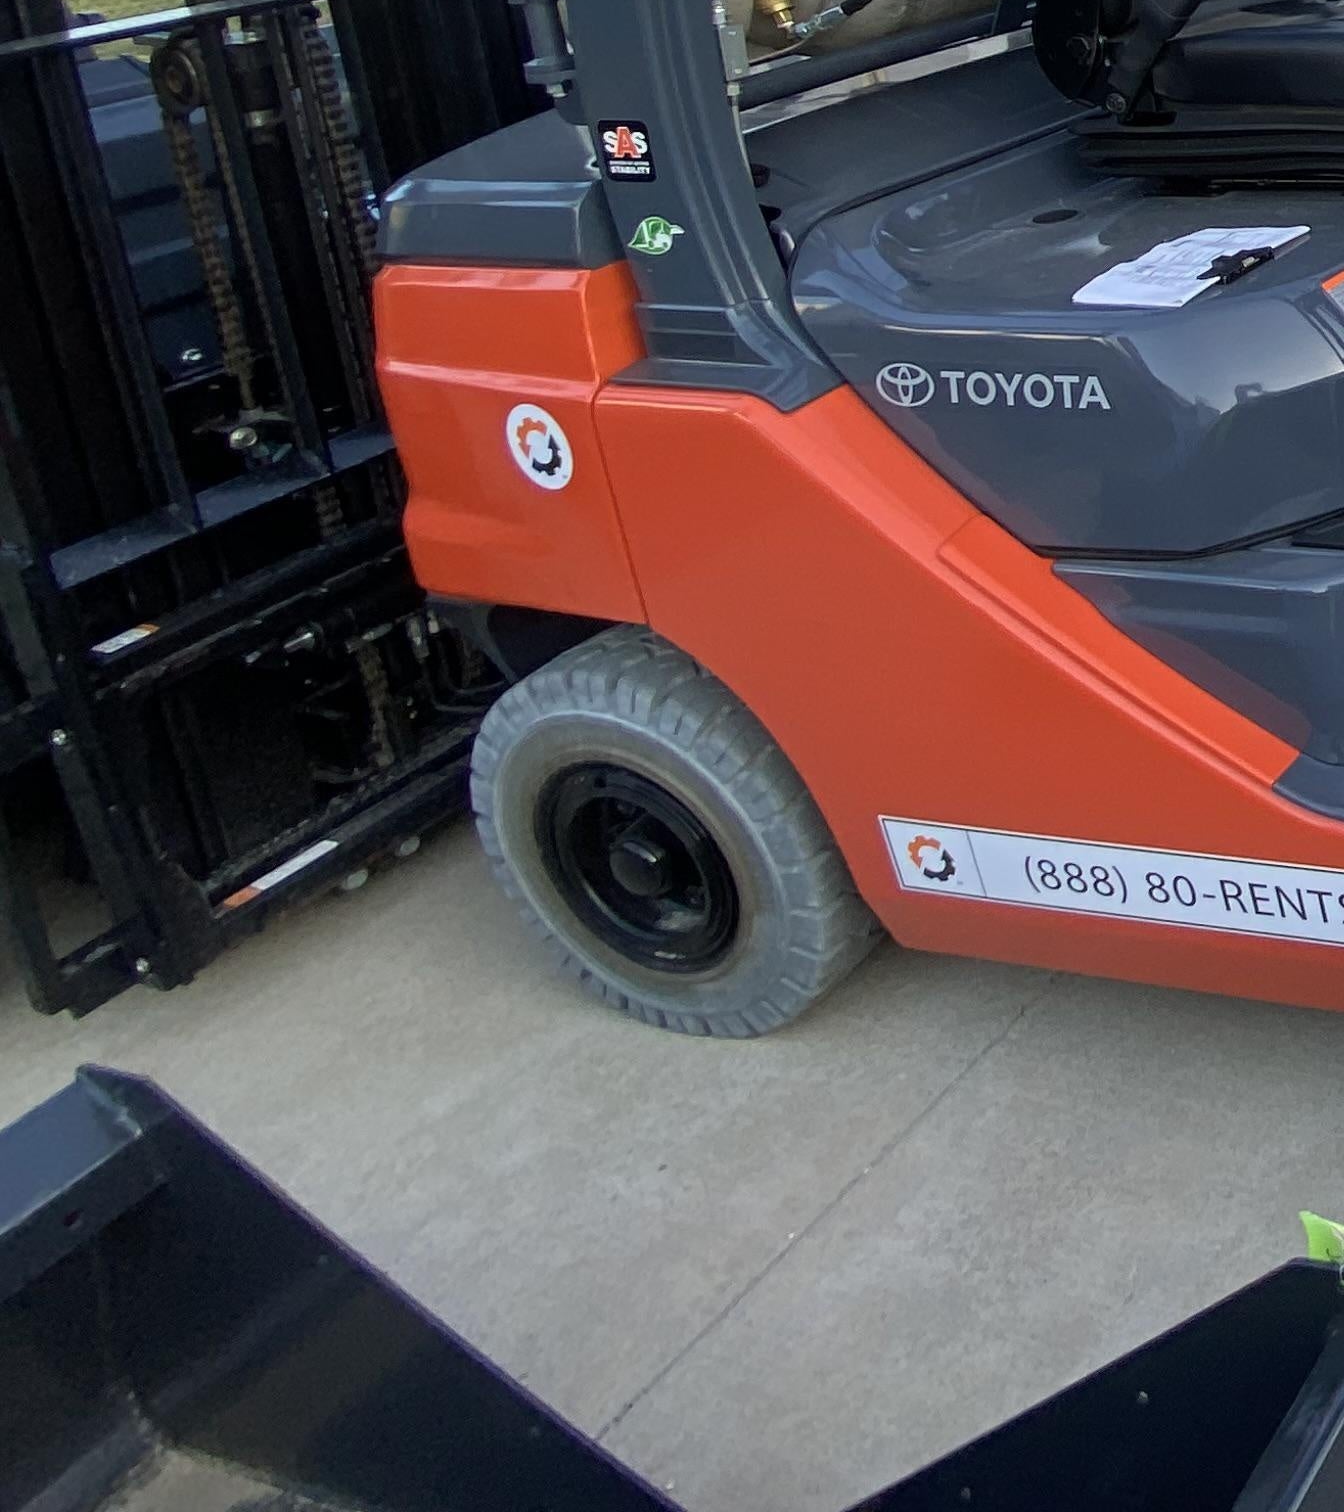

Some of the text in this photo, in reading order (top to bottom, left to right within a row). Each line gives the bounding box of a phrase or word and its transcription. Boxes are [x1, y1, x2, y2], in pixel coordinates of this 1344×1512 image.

[603, 126, 648, 158] SAS
[940, 370, 1111, 410] TOYOTA
[1024, 855, 1128, 904] (888)
